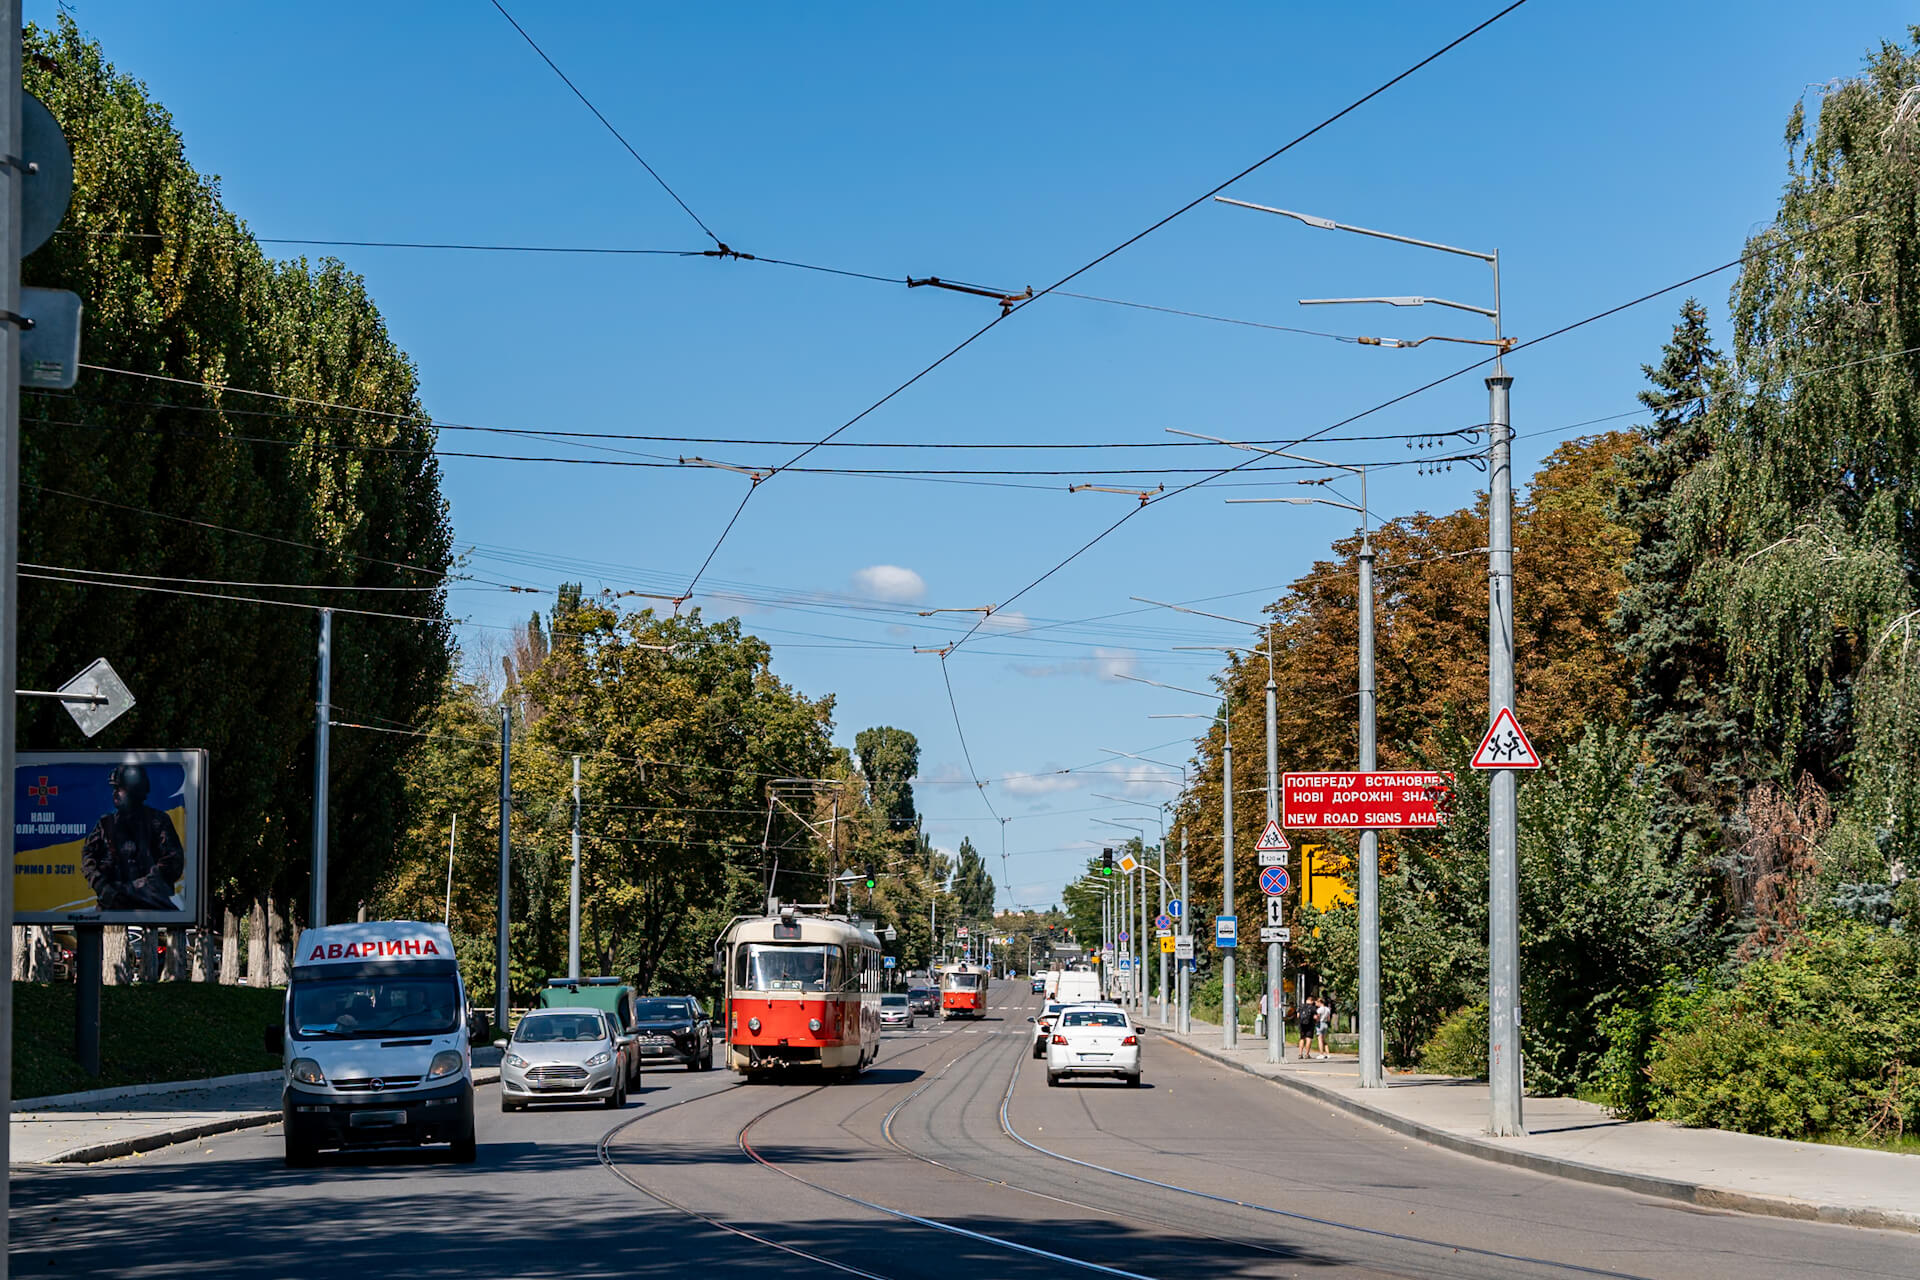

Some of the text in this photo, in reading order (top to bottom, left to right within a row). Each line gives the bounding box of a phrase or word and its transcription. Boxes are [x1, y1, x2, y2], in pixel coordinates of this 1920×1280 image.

[1287, 776, 1356, 789] ПОПЕРЕДУ
[1293, 791, 1324, 803] НОВІ
[1332, 791, 1393, 804] ДОРОЖНІ
[31, 812, 55, 823] НАШІ
[1287, 813, 1317, 824] NEW
[1323, 813, 1359, 824] ROAD
[1364, 812, 1402, 824] SIGNS
[14, 824, 86, 834] ОЛИ-ОХОРОНЦІ!
[55, 865, 75, 874] ЗСУ!
[309, 938, 440, 961] АВАРІЙНА
